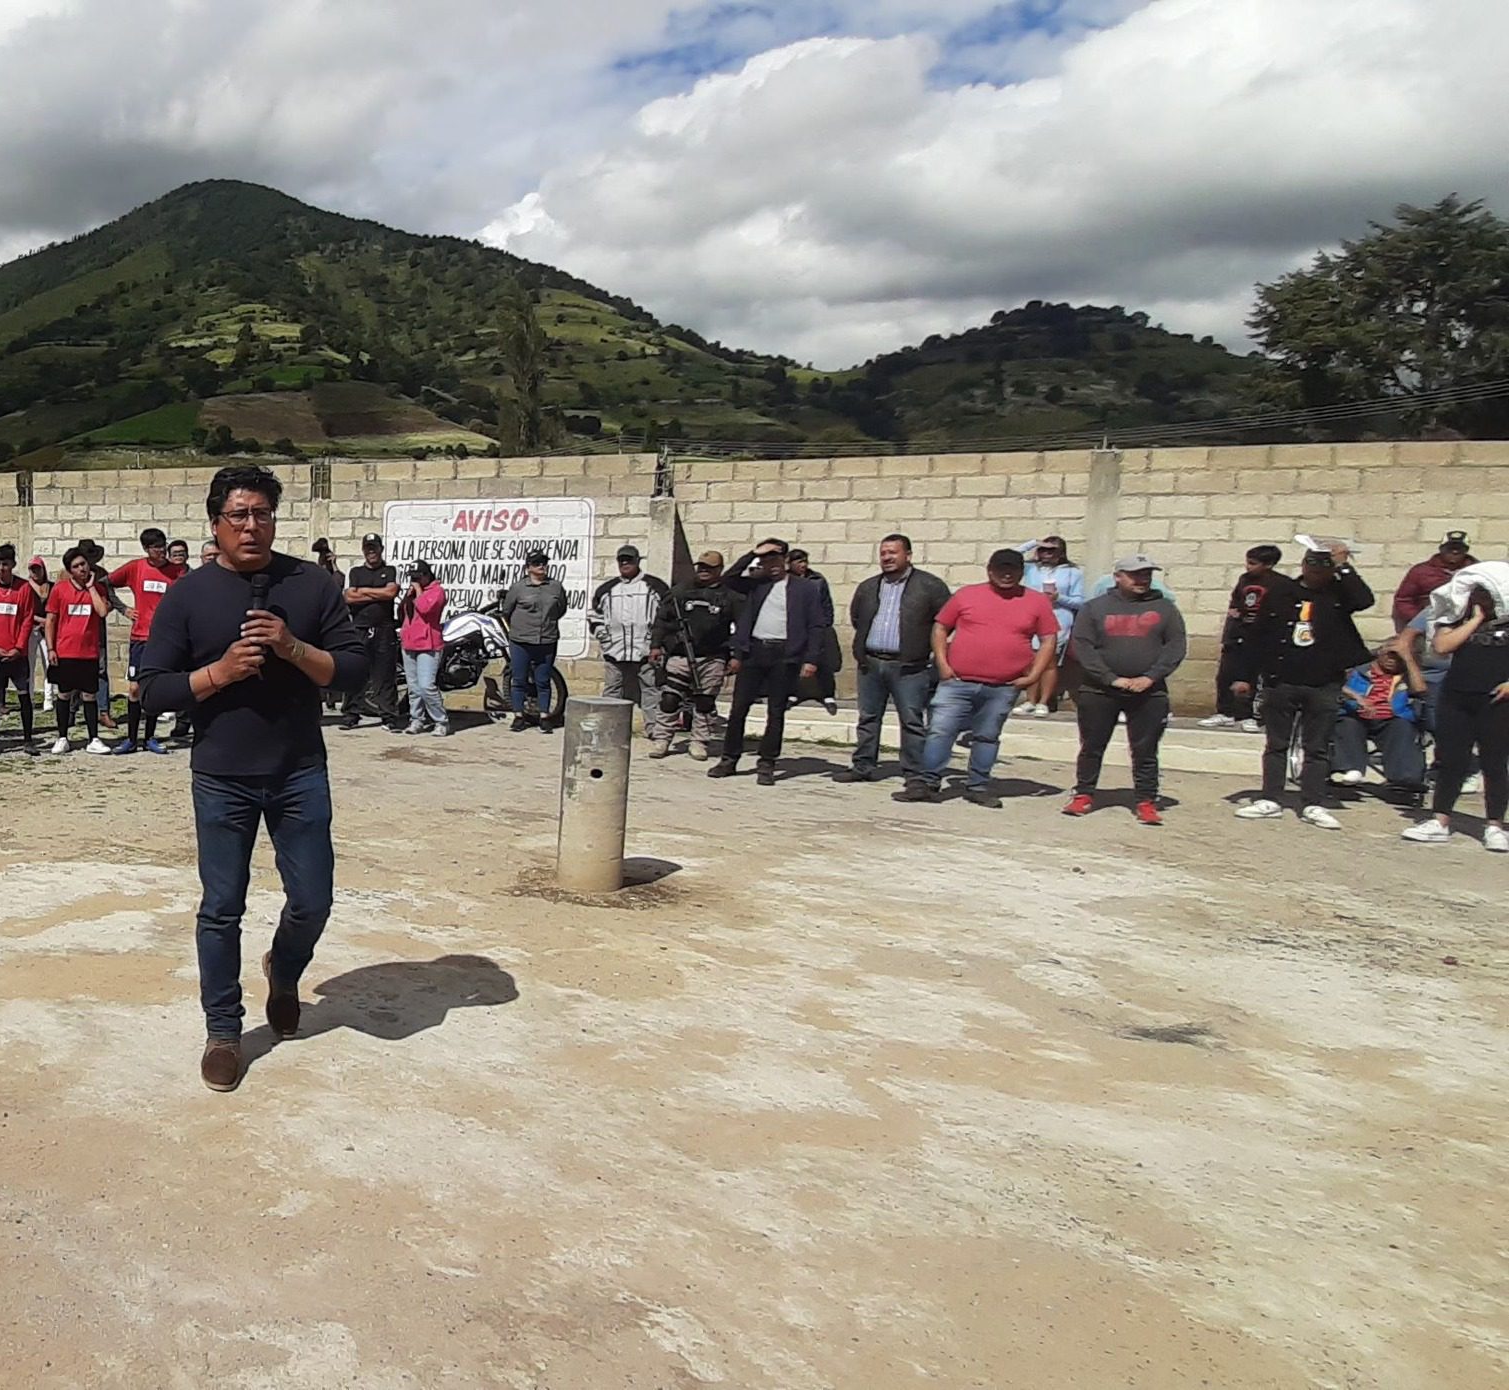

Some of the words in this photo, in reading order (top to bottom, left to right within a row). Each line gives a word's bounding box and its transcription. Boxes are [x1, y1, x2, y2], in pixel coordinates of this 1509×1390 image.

[452, 508, 530, 532] AVISO
[392, 541, 398, 560] A
[402, 540, 414, 560] LA
[418, 540, 466, 560] PERSONA
[469, 540, 490, 562] QUE
[492, 539, 507, 560] SE
[469, 564, 477, 585] O
